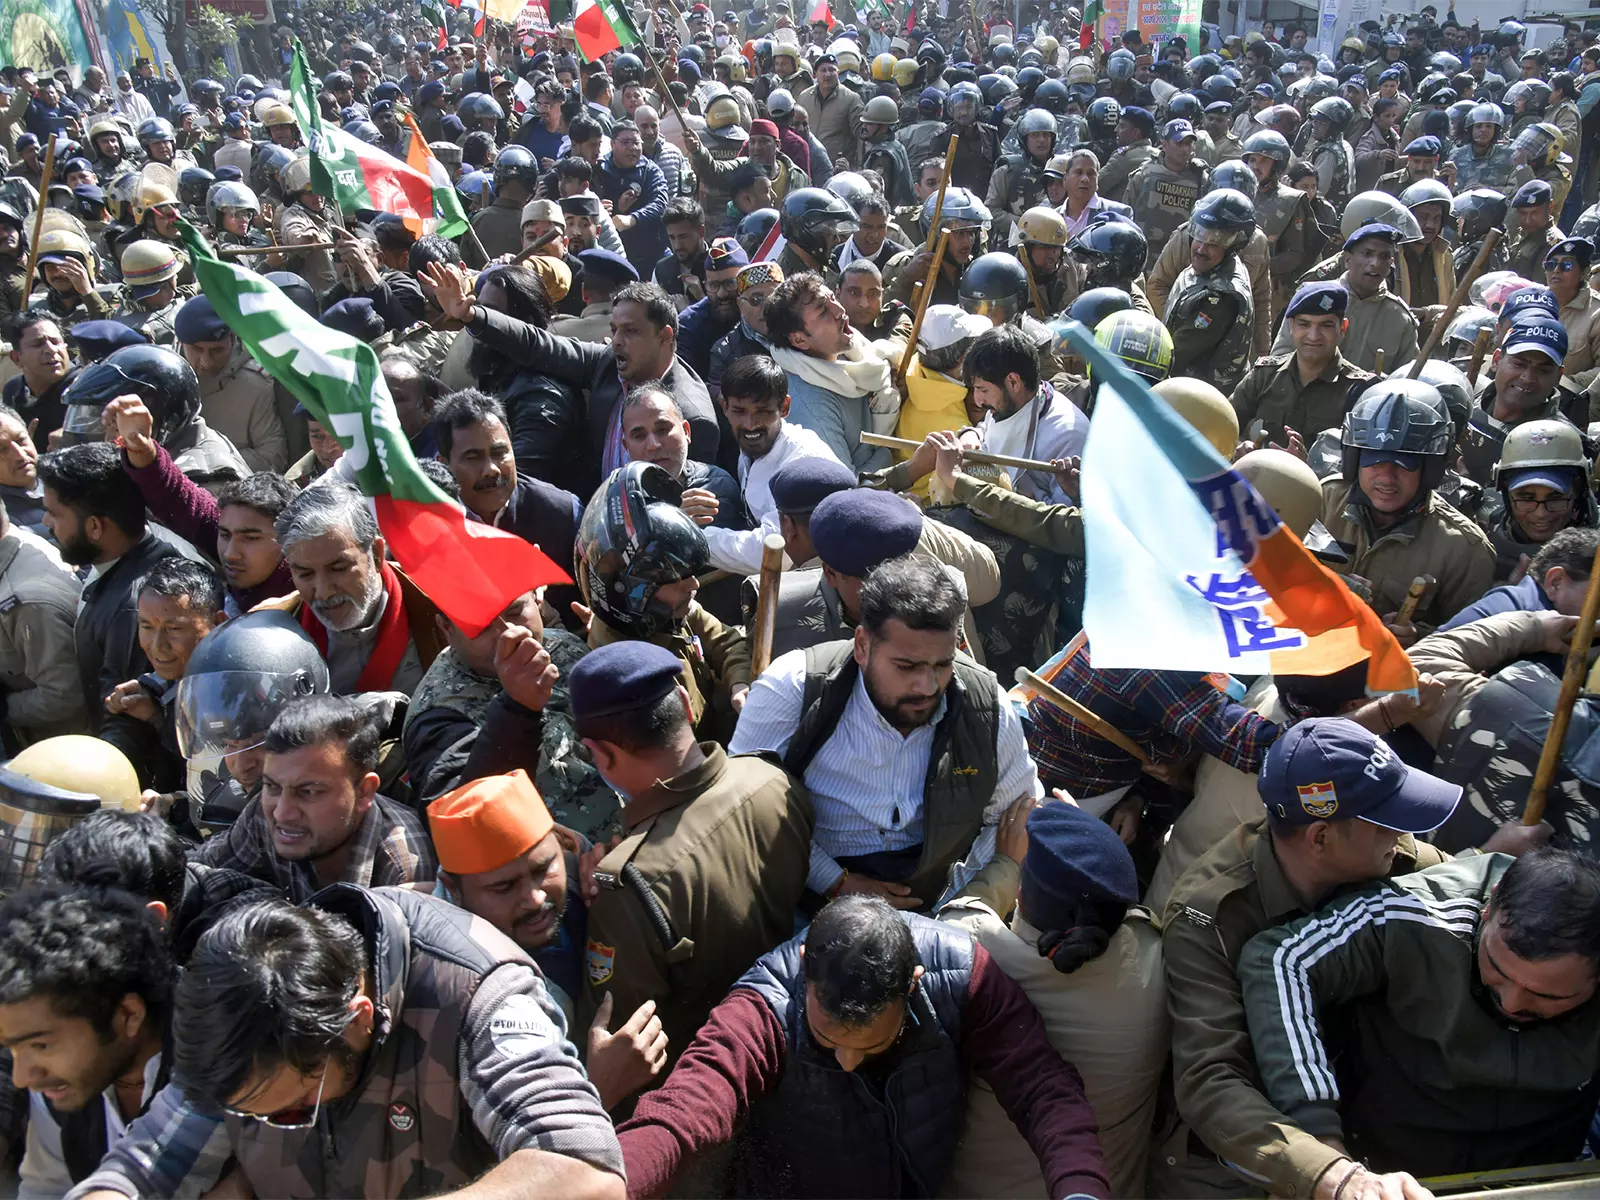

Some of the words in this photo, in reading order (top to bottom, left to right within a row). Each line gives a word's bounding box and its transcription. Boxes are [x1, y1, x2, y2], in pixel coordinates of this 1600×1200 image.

[1163, 194, 1191, 209] POLICE
[1515, 294, 1554, 308] POLICE
[1525, 326, 1559, 342] POLICE
